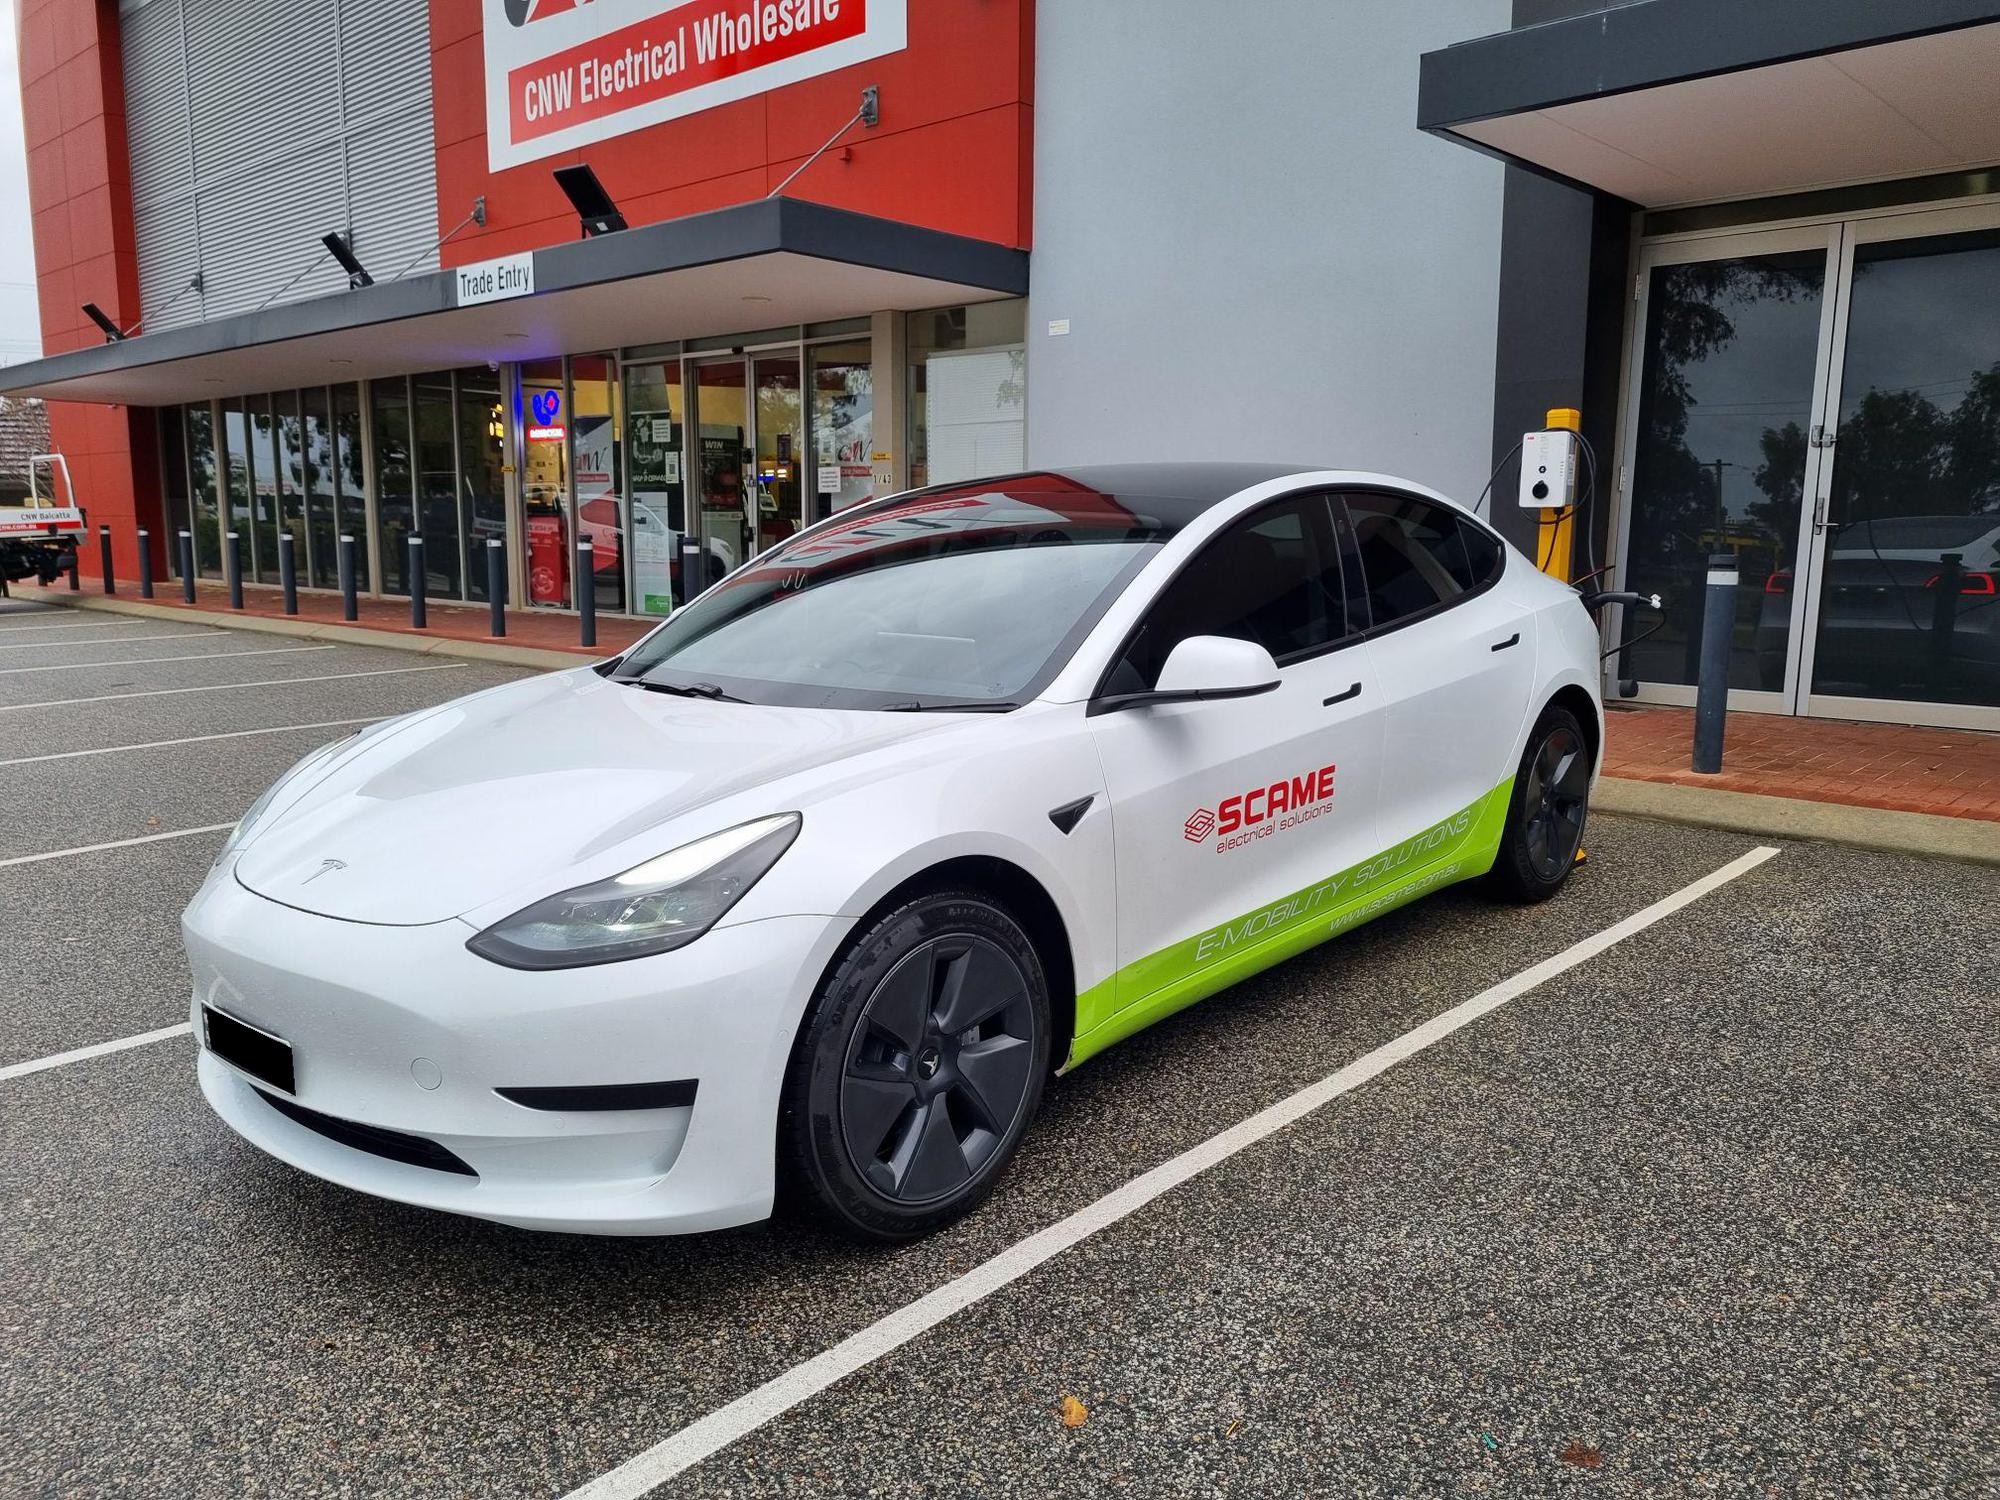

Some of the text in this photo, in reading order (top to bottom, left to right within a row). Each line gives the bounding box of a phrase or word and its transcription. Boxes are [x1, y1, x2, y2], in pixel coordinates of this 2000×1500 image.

[524, 67, 573, 122] CNW
[579, 28, 686, 104] Electrical
[460, 264, 530, 298] Trade Entry
[704, 440, 724, 450] WIN
[1216, 801, 1333, 854] electrical solutions
[1217, 764, 1336, 836] SCAME
[1195, 810, 1471, 962] E-MOBILITY SOLUTIONS
